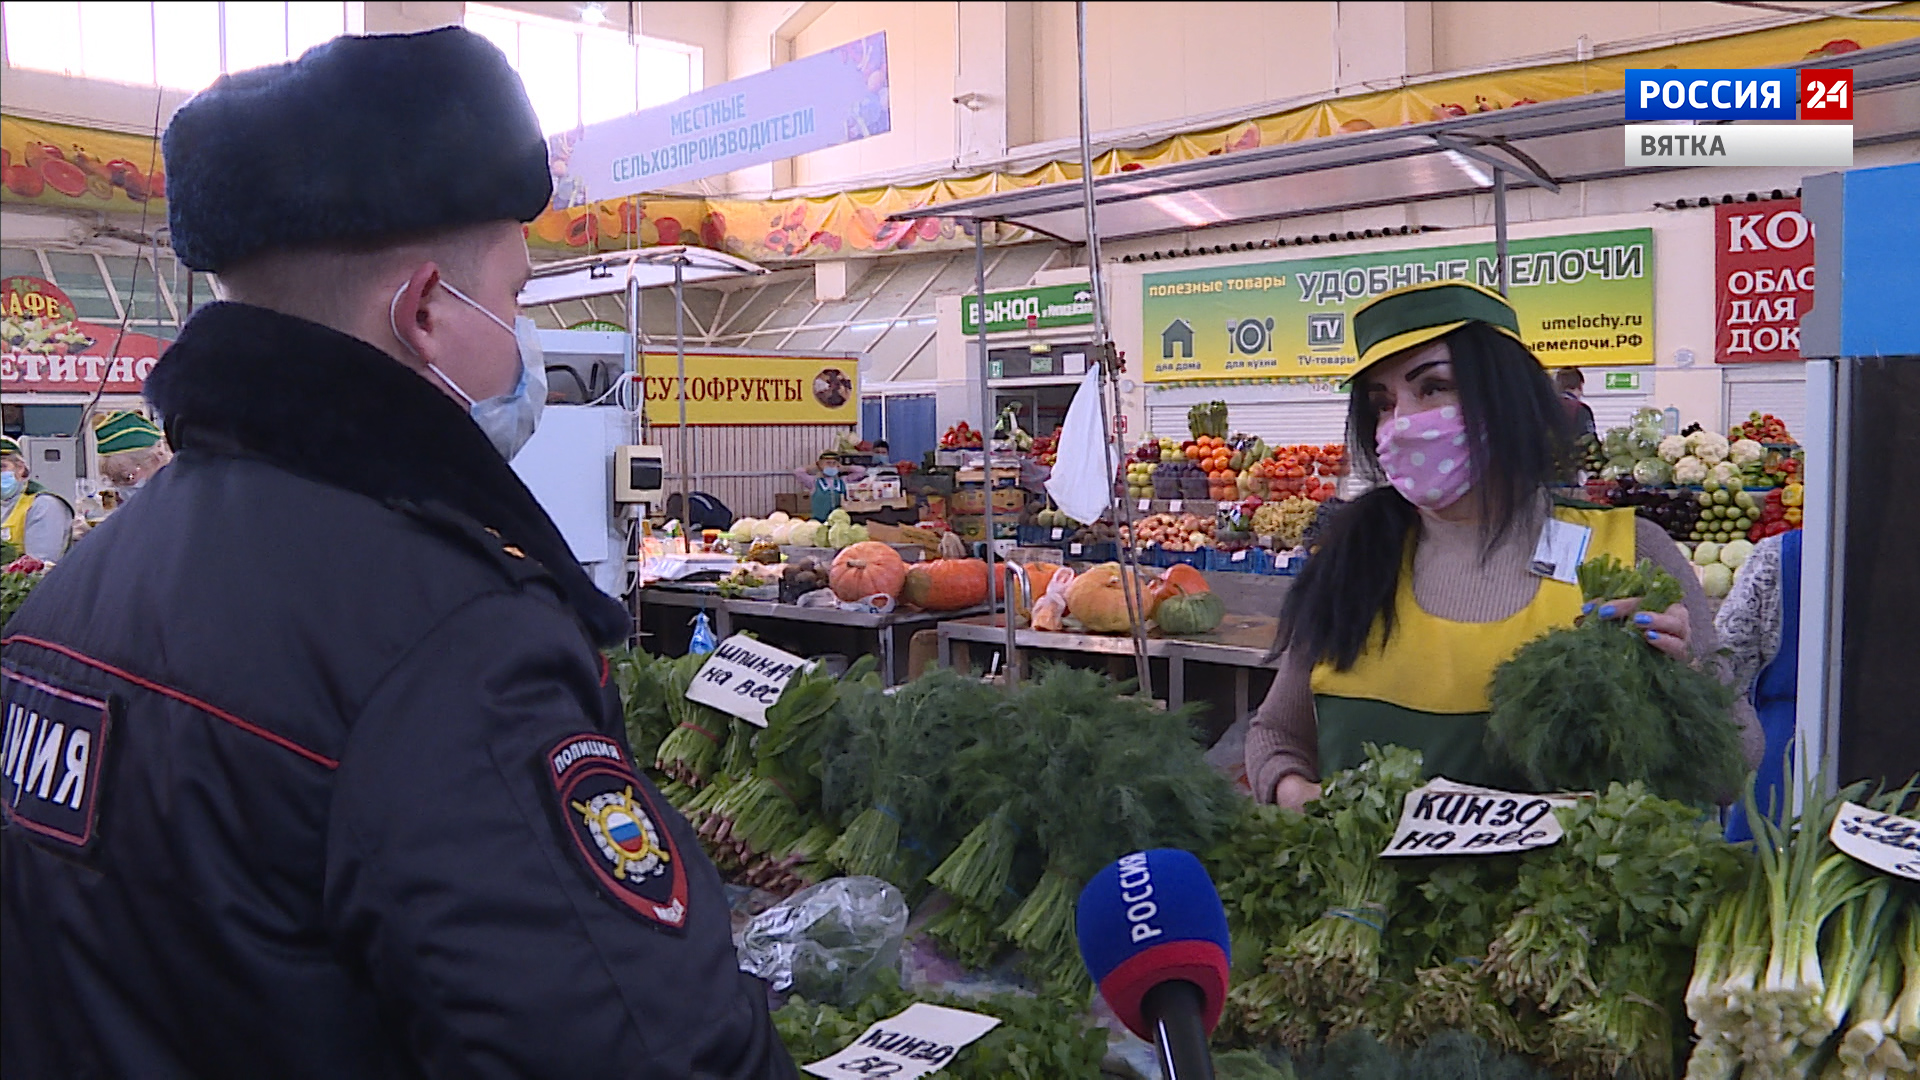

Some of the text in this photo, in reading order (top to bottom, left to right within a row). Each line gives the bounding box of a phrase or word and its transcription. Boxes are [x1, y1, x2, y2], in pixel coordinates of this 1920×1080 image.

[671, 93, 746, 135] МЕСТНЫЕ
[612, 107, 815, 182] СЕЛЬХОЗПРОИЗВОДИТЕЛИ
[1728, 211, 1815, 252] КО
[1477, 245, 1643, 287] МЕЛОЧИ
[1149, 275, 1286, 297] полезные товары
[969, 297, 1040, 325] ВЫХОД
[1542, 313, 1643, 331] umelochy.ru
[1727, 297, 1796, 325] ДЛЯ
[1312, 319, 1340, 339] TV
[644, 376, 803, 402] СУХОФРУКТЫ
[554, 740, 621, 773] ПОЛИЦИЯ
[1118, 851, 1163, 944] РОССИЯ
